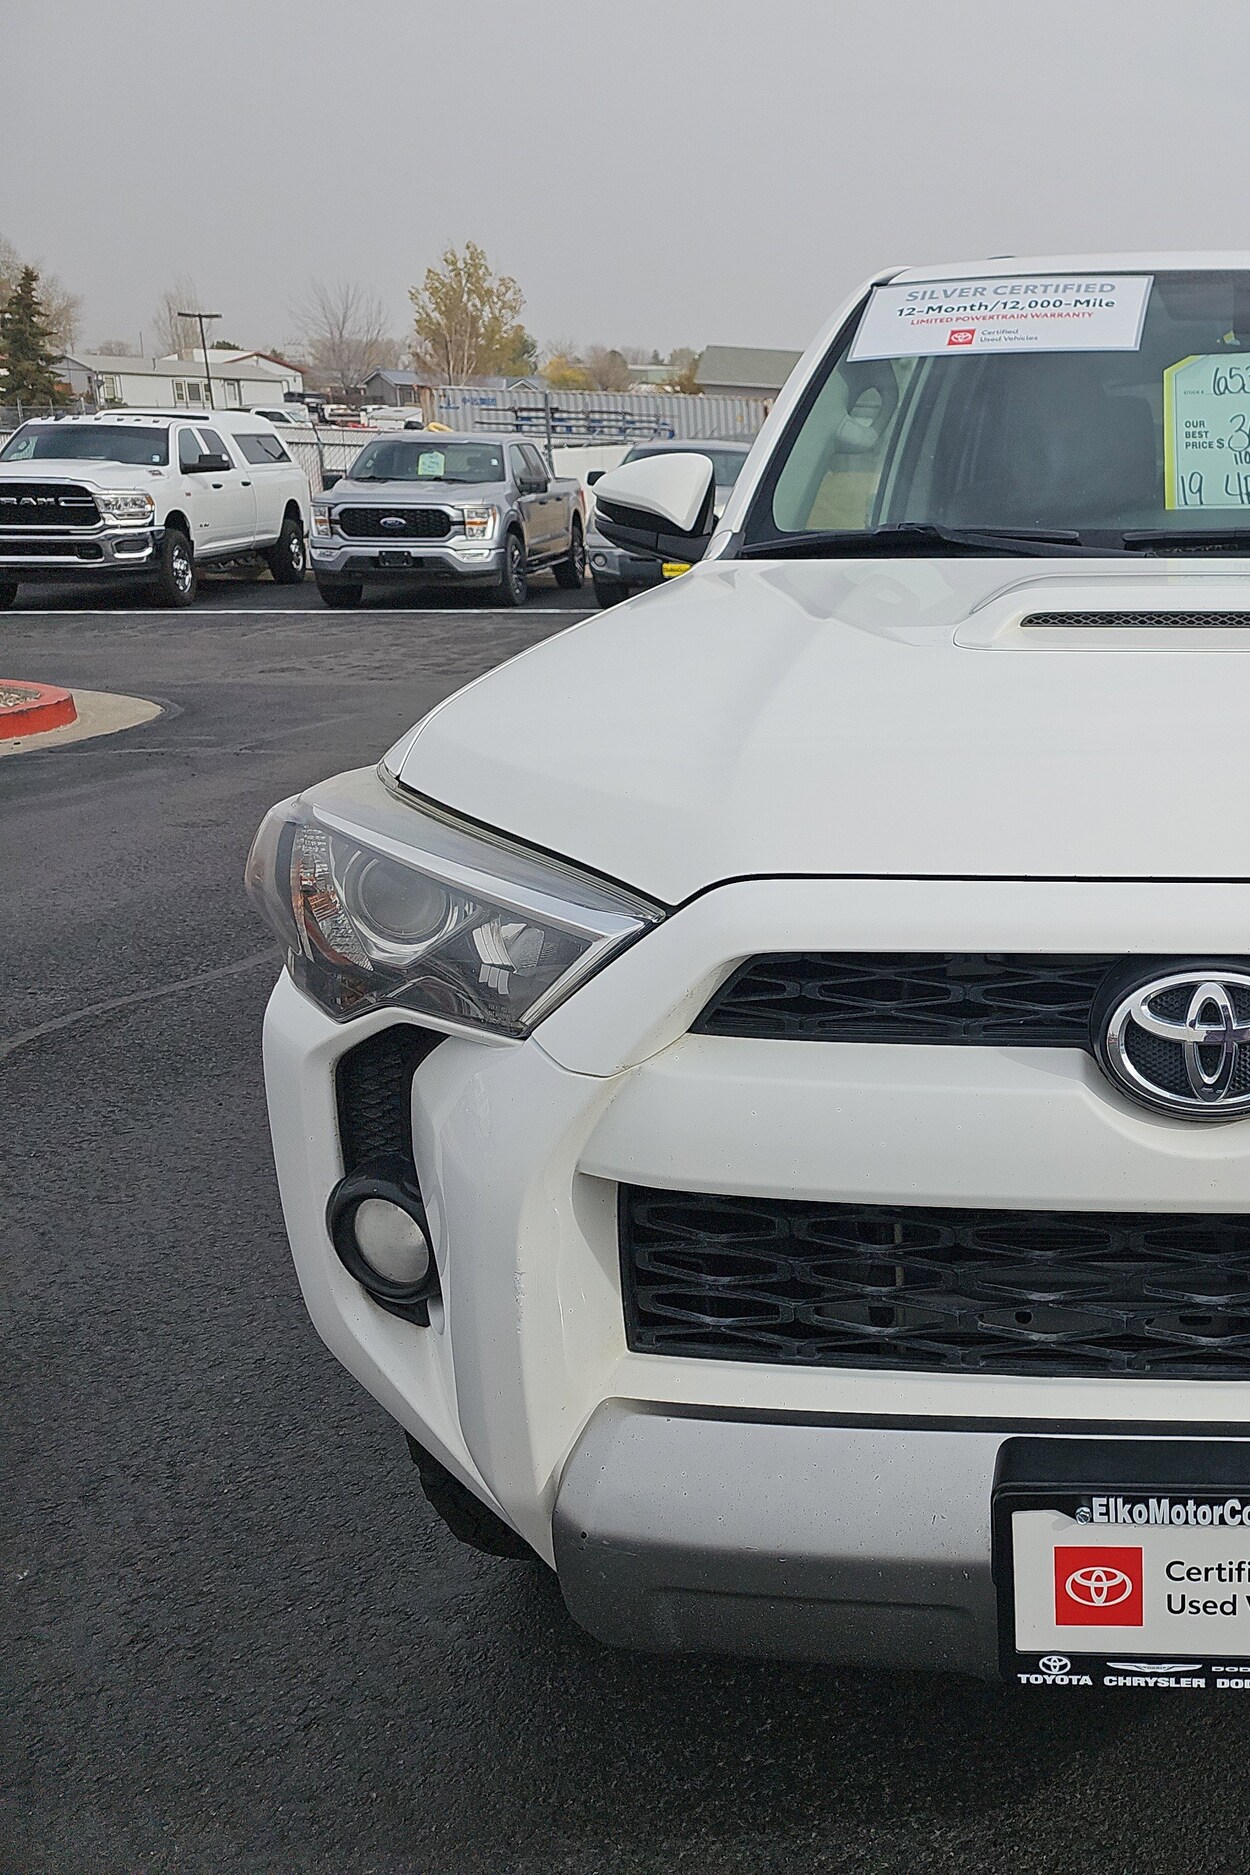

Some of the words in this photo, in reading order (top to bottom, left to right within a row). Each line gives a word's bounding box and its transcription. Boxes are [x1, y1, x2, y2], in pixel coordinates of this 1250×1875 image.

[906, 286, 988, 302] SILVER
[993, 282, 1116, 295] CERTIFIED
[896, 297, 1116, 317] 12-Month/12,000-Mile
[910, 316, 953, 326] LIMITED
[954, 313, 1028, 323] POWERTRAIN
[1030, 311, 1094, 319] WARRANTY
[980, 335, 1001, 343] Used
[1003, 334, 1038, 342] Vehicles
[981, 328, 1019, 336] Certified
[1184, 420, 1206, 429] OUR
[1184, 430, 1210, 439] BEST
[1185, 441, 1214, 449] PRICE
[1180, 471, 1204, 506] 19
[1166, 1594, 1237, 1617] Used
[1016, 1674, 1093, 1686] TOYOTA
[1103, 1676, 1206, 1688] CHRYSLER
